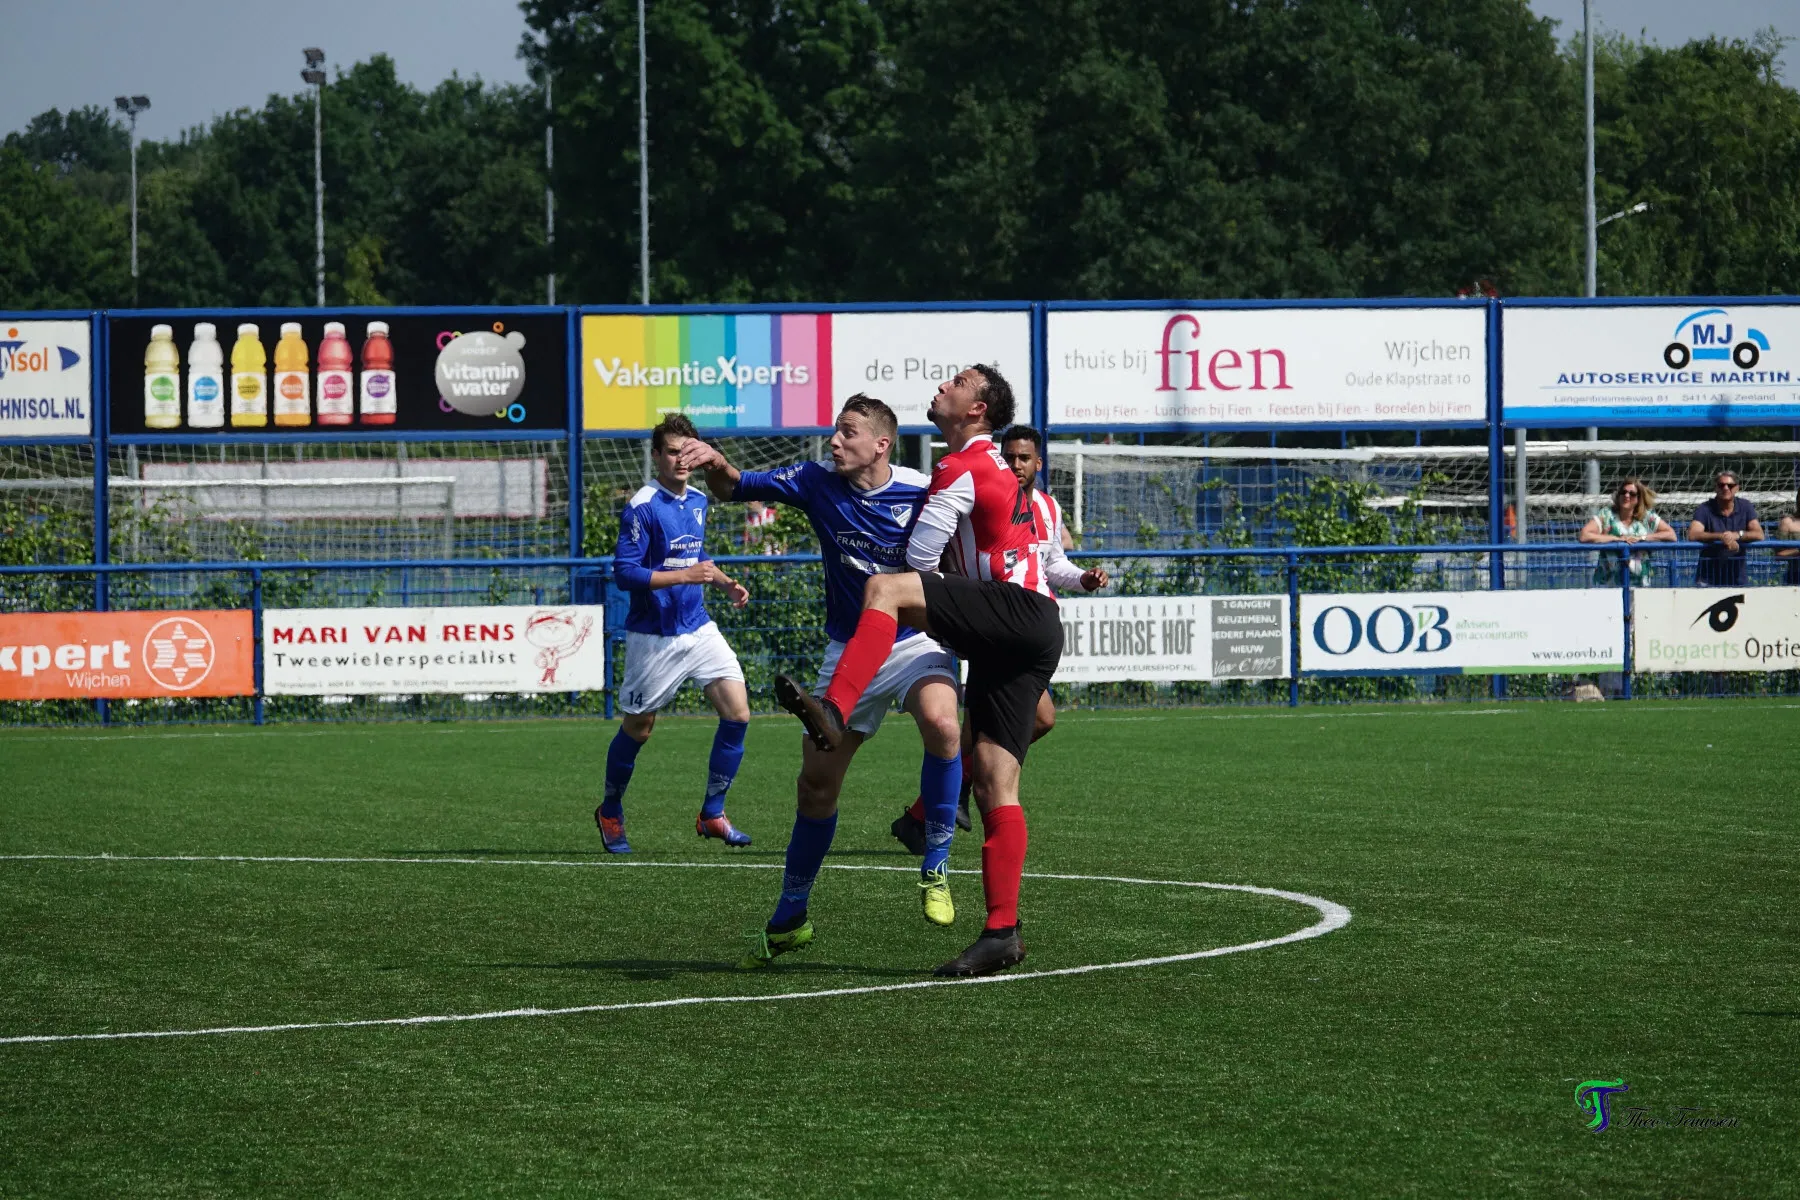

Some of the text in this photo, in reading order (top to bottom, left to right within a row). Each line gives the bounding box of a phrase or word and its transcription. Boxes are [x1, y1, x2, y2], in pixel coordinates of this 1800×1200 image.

[1692, 324, 1733, 345] MJ
[1065, 314, 1294, 391] thuis bij fien
[1385, 340, 1471, 367] Wijchen
[593, 356, 809, 389] VakantieXperts
[866, 359, 893, 381] de
[1557, 371, 1790, 384] AUTOSERVICE MARTIN
[1345, 372, 1471, 388] Oude Klapstraat 10
[452, 381, 511, 396] water
[1734, 393, 1776, 401] Zeeland
[1065, 401, 1472, 420] Eten bij Fien Lunchen bij Fien Feesten bij Fien Borrelen bij Fien
[837, 536, 871, 550] FRANK
[1222, 600, 1271, 609] 3 GANGEN
[1217, 615, 1276, 624] KEUZEMENU
[1455, 621, 1500, 630] adviseurs
[272, 624, 514, 643] MARI VAN RENS
[1062, 619, 1196, 656] DE LEURSE HOF
[1246, 630, 1282, 639] MAAND
[1469, 630, 1529, 641] accountants
[1230, 645, 1264, 654] NIEUW
[1532, 647, 1613, 660] www.oovb.nl
[1649, 639, 1740, 664] Bogaerts
[274, 651, 518, 668] Tweewielerspecialist
[1096, 664, 1197, 673] WWW.LEURSEHOF.NL
[66, 672, 131, 689] Wijchen
[629, 691, 644, 707] 14
